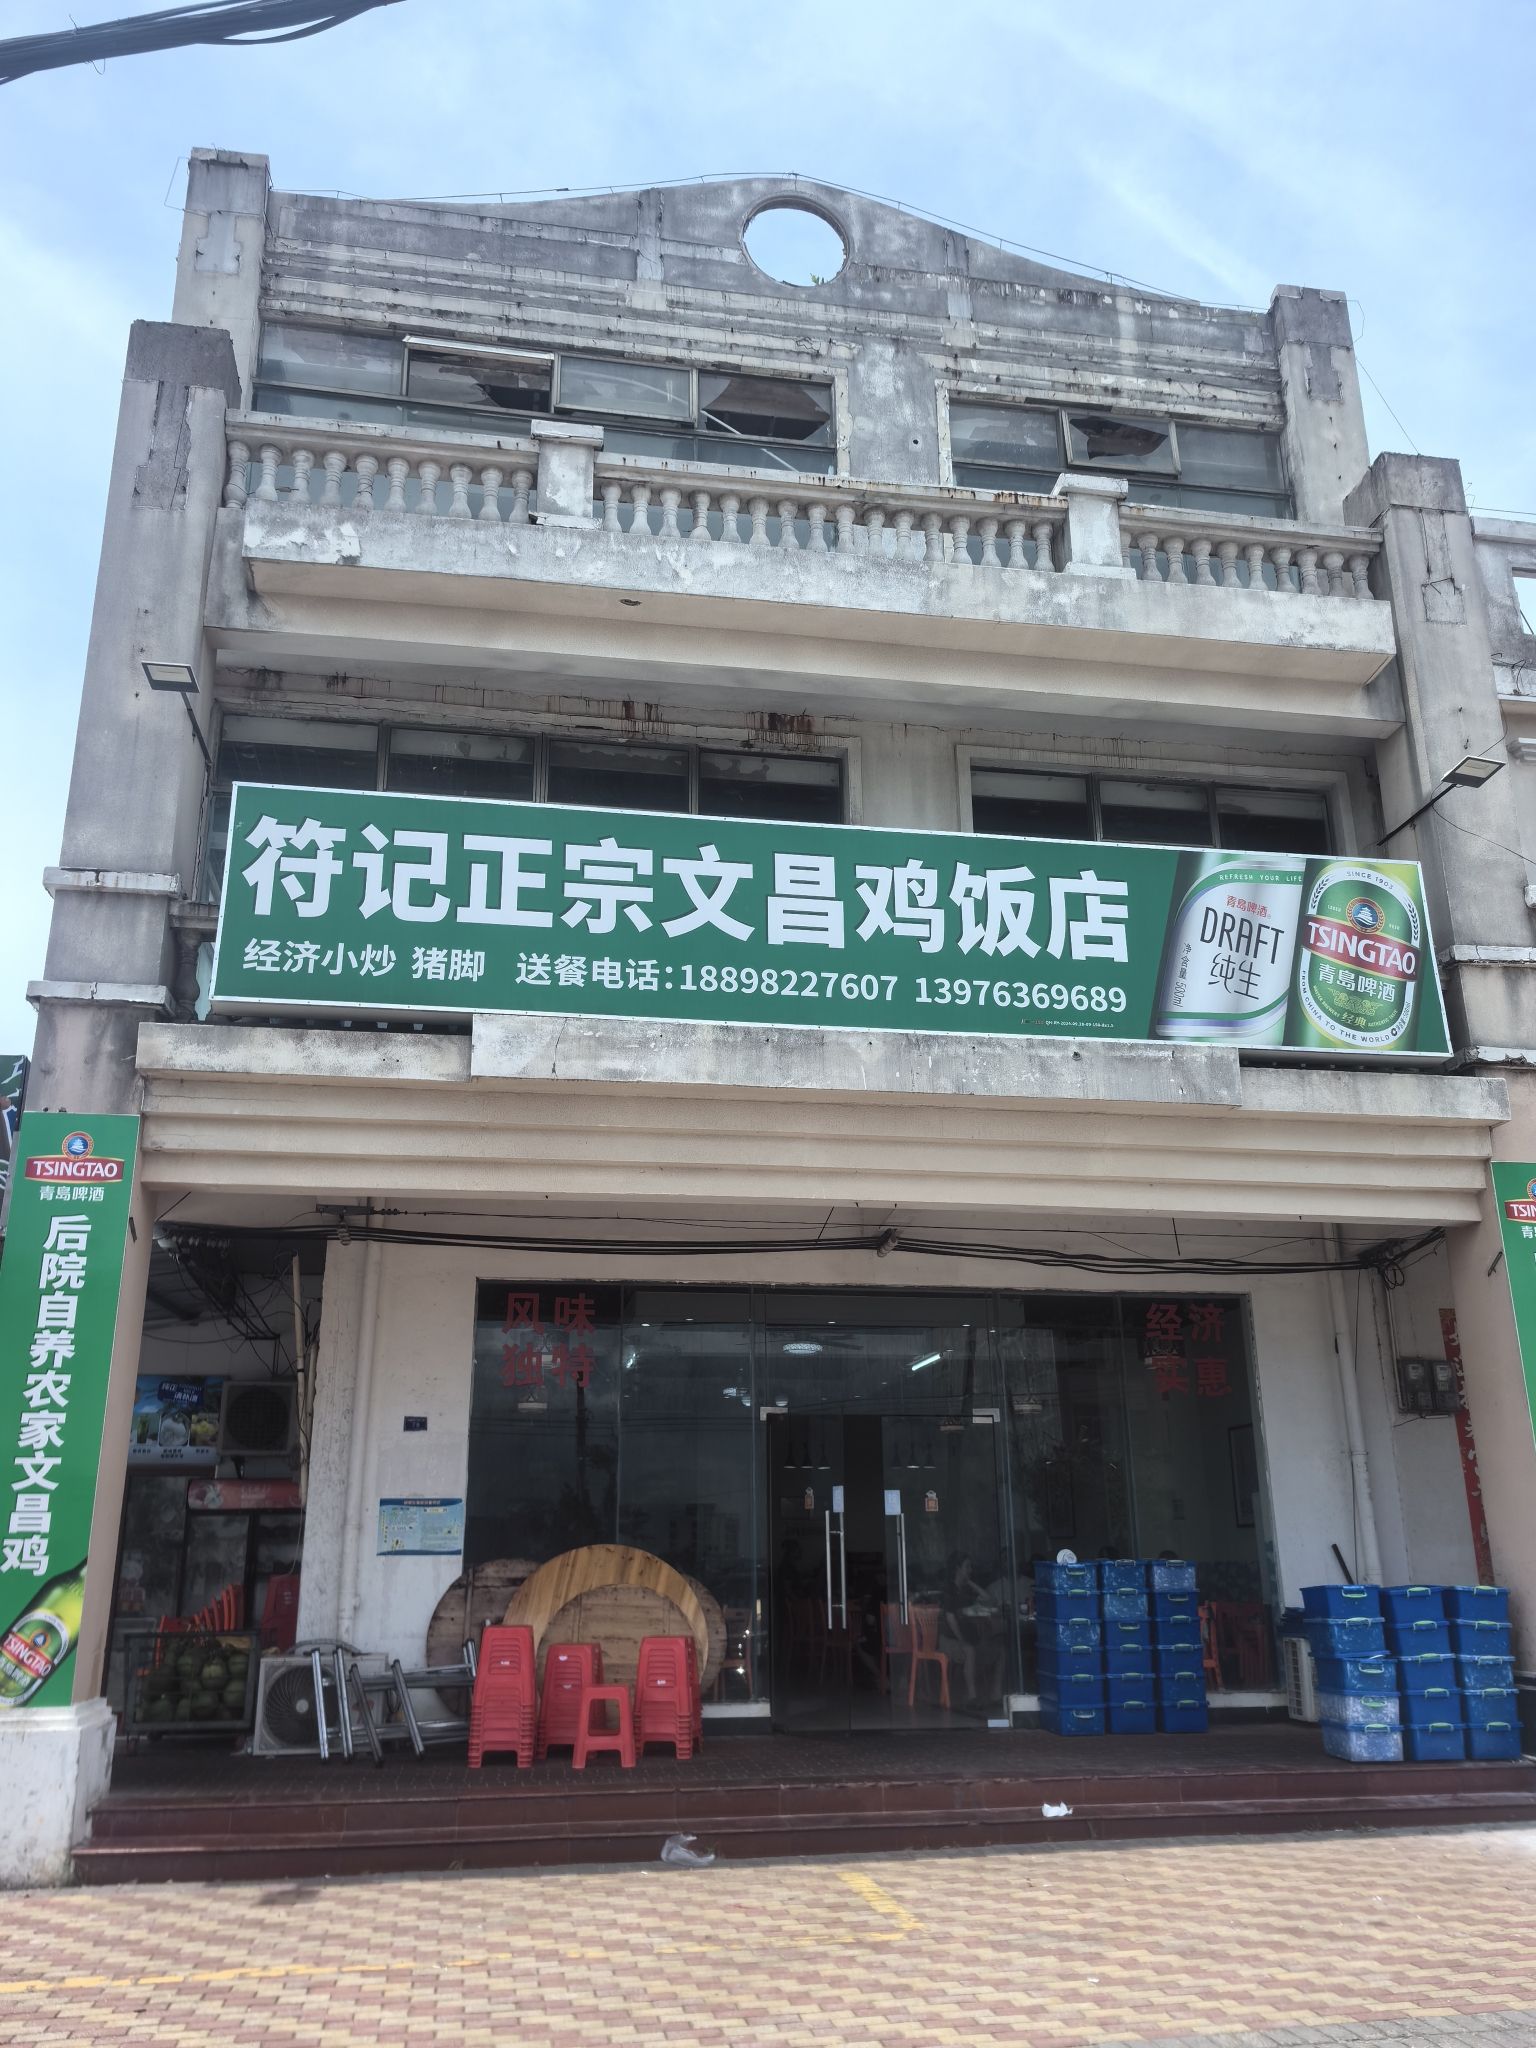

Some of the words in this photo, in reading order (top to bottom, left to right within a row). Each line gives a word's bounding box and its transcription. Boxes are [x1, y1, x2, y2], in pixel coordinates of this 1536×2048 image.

[242, 814, 1130, 964] 符记正宗文昌鸡饭店
[1219, 873, 1254, 881] REFRESH
[1346, 871, 1372, 880] SINCE
[1374, 876, 1394, 890] 1903
[1200, 906, 1285, 965] DRAFT
[1308, 921, 1417, 975] TSINGTAO
[243, 937, 396, 978] 经济小炒
[411, 945, 486, 983] 猪脚
[915, 976, 1127, 1014] 13976369689
[1208, 952, 1262, 1000] 纯生
[1305, 996, 1323, 1021] CHINA
[1325, 1020, 1336, 1031] TO
[1340, 1029, 1357, 1041] THE
[1361, 1034, 1390, 1043] WORLD
[33, 1160, 118, 1178] TSINGTAO
[502, 1292, 596, 1336] 风味
[1144, 1302, 1225, 1344] 经济
[501, 1341, 597, 1388] 独特
[1152, 1353, 1233, 1401] 实惠
[0, 1214, 92, 1577] 后院自养农家文昌鸡
[3, 1633, 51, 1677] TSINGTAO
